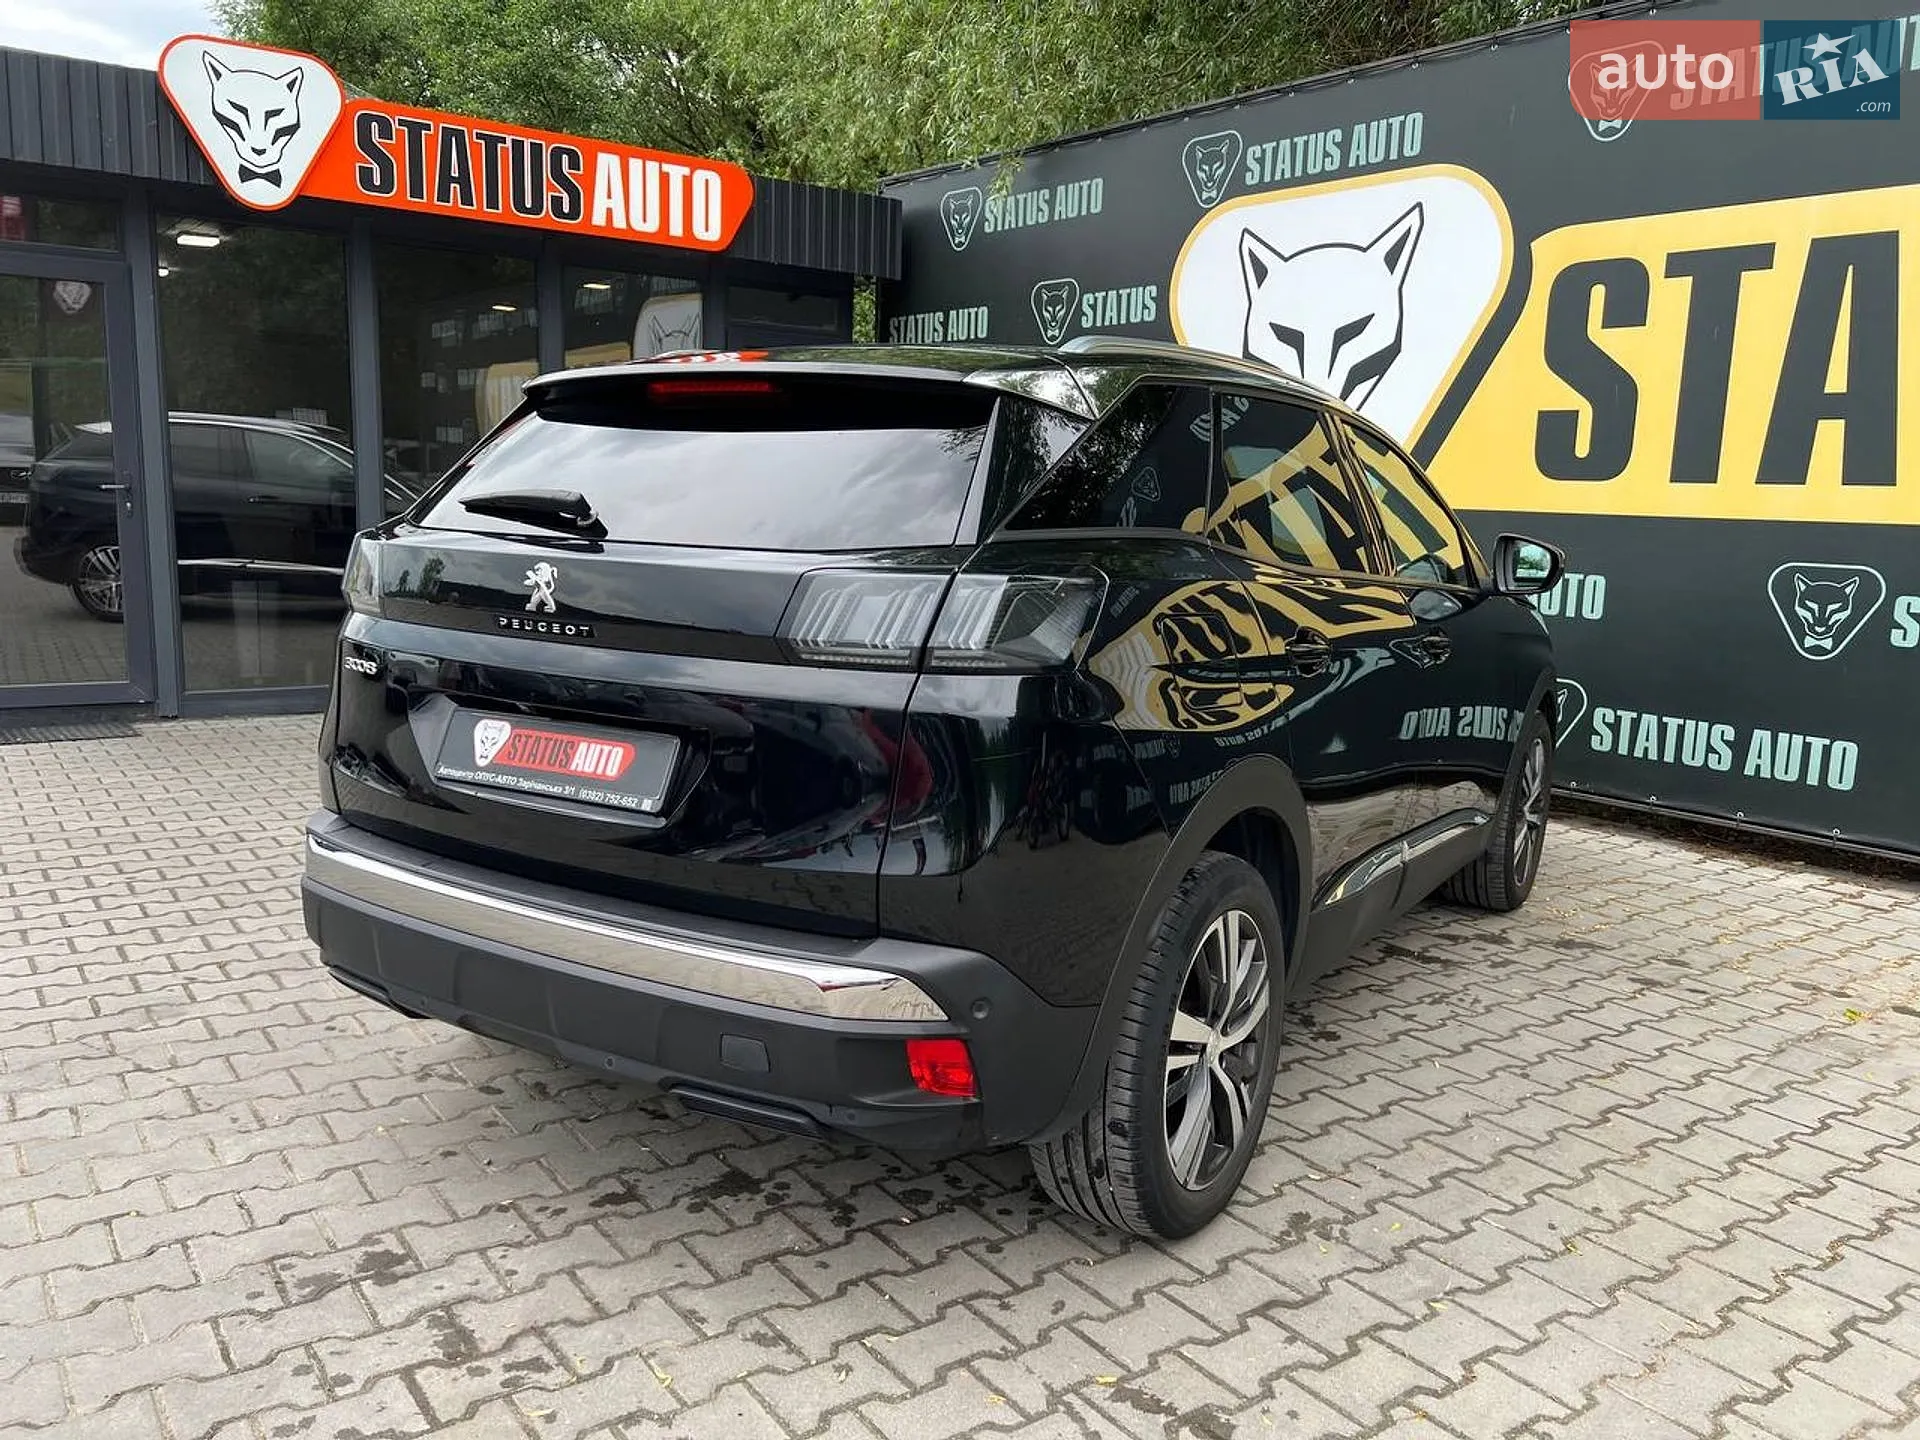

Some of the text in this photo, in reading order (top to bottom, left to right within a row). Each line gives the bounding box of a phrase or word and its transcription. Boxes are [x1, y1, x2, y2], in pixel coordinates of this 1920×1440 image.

[354, 110, 722, 242] STATUS AUTO
[1245, 112, 1424, 186] STATUS AUTO
[984, 178, 1103, 233] STATUS AUTO
[889, 306, 988, 344] STATUS AUTO
[1081, 285, 1157, 328] STATUS
[1535, 230, 1899, 485] STA
[500, 617, 589, 636] PEUGEOT
[507, 732, 624, 777] STATUS AUTO
[1591, 707, 1735, 772] STATUS
[1743, 729, 1858, 792] AUTO
